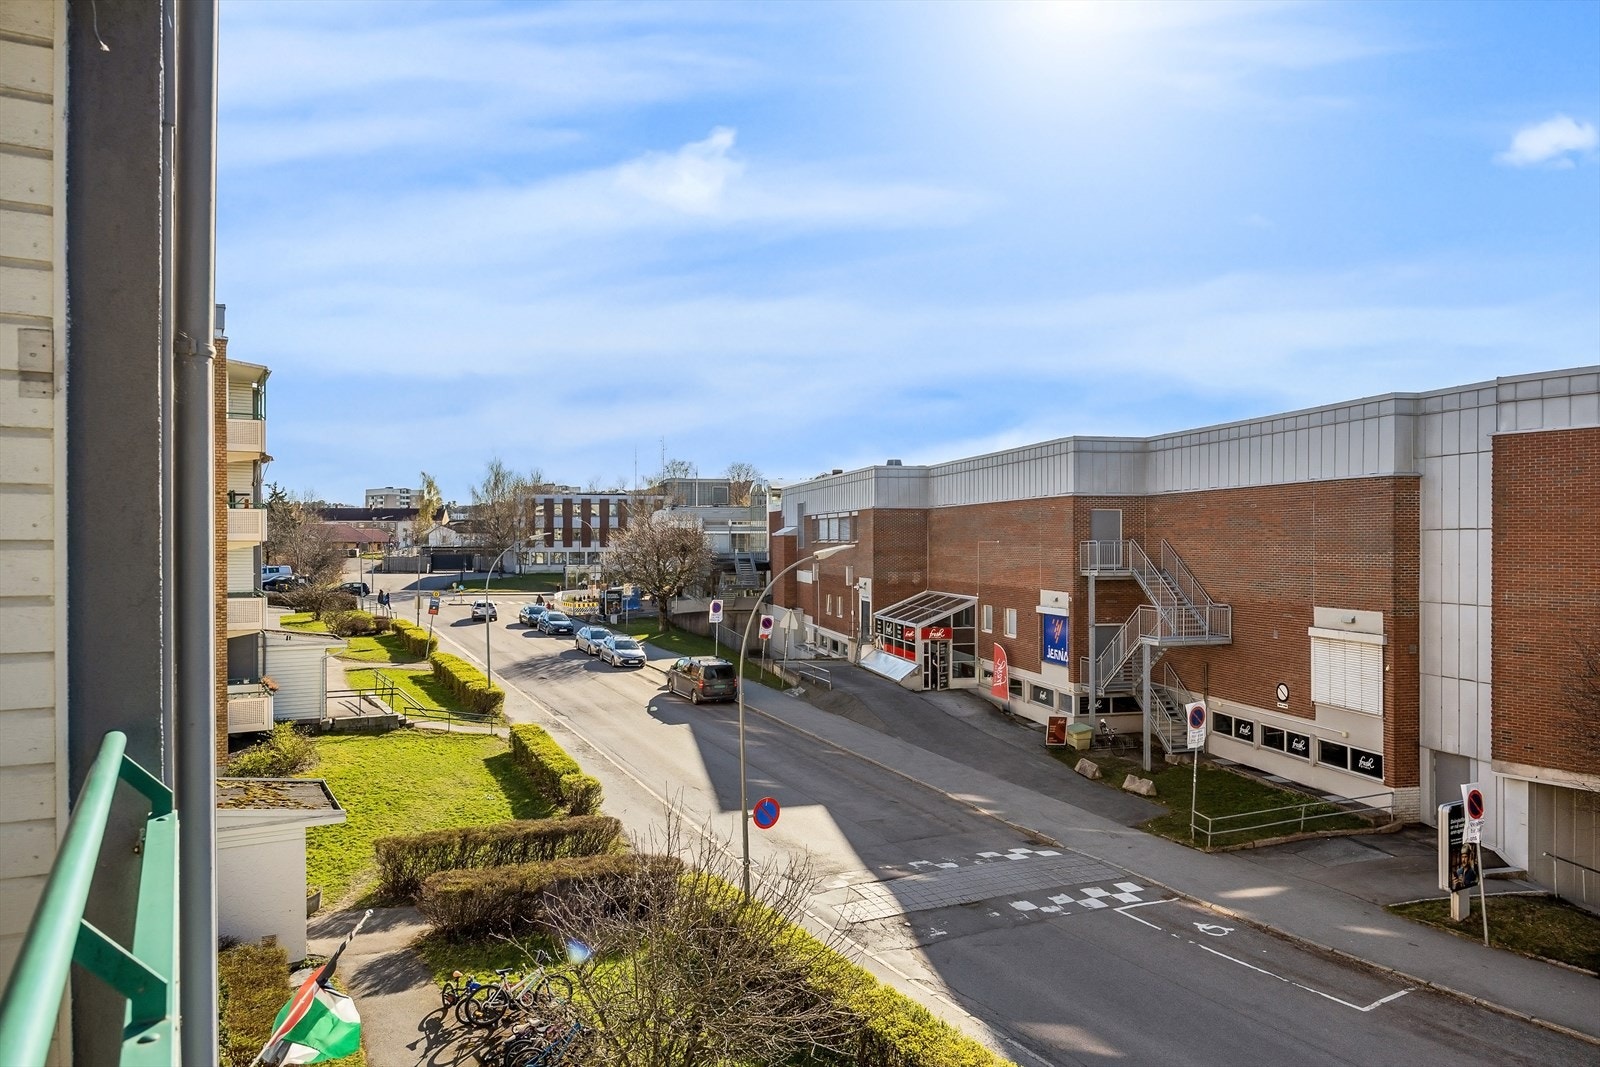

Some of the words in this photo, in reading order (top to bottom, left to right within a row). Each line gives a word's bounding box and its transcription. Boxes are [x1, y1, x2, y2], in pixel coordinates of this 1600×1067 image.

[928, 628, 946, 639] fresh
[1292, 738, 1306, 750] fresh
[1358, 756, 1375, 769] fresh
